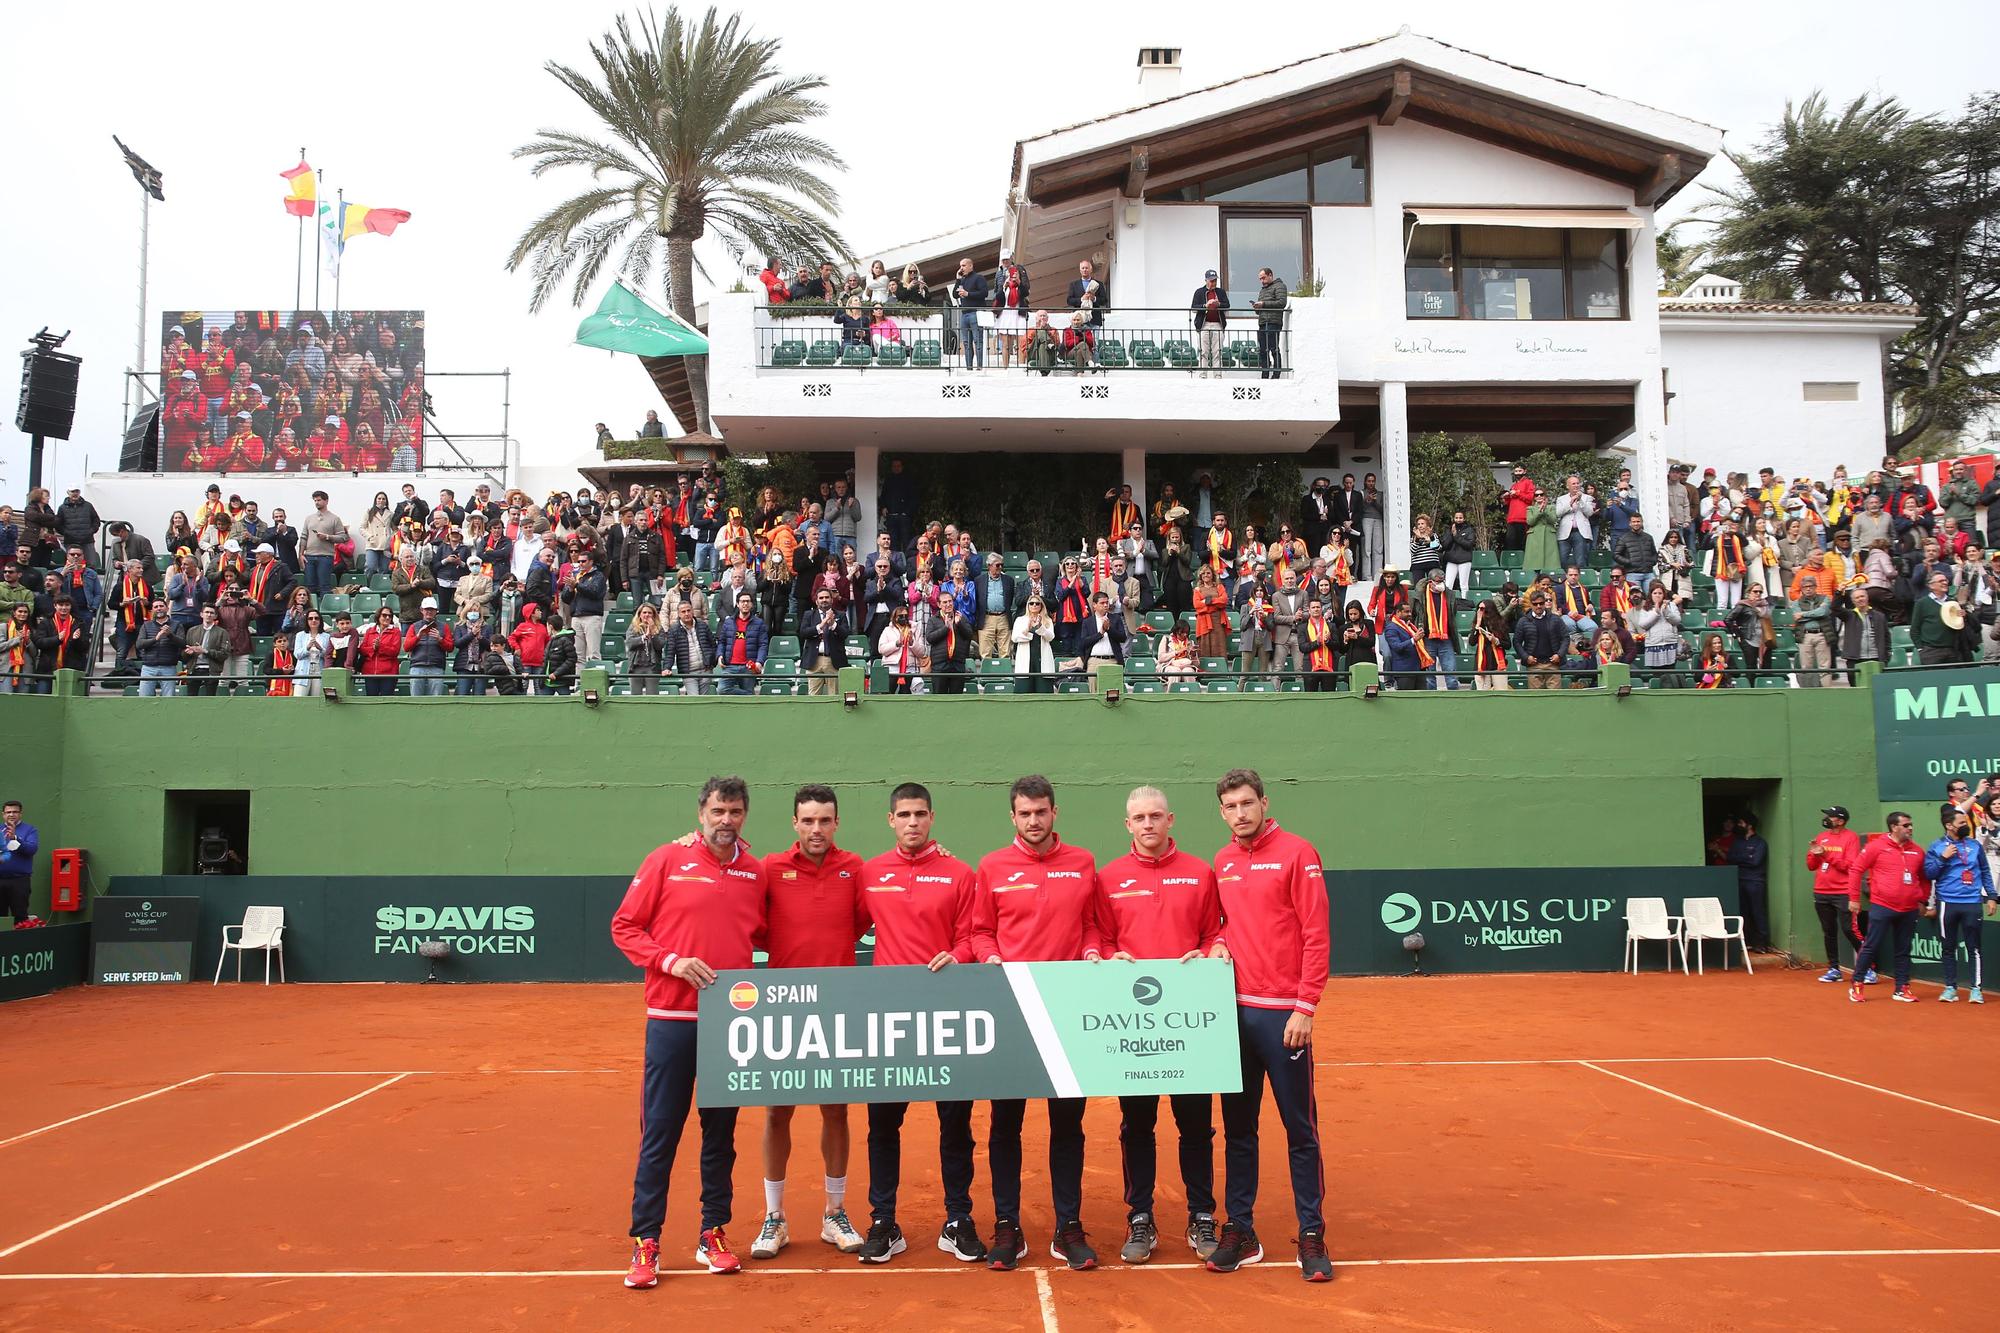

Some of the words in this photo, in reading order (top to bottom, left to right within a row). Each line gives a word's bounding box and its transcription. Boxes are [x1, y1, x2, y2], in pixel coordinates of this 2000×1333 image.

[375, 904, 536, 934] $DAVIS
[1430, 900, 1530, 924] DAVIS
[1540, 898, 1612, 922] CUP
[375, 935, 431, 954] FAN
[439, 935, 535, 954] TOKEN
[1464, 934, 1478, 947] by
[1481, 926, 1562, 950] Rakuten
[103, 972, 130, 982] SERVE
[131, 972, 159, 981] SPEED
[160, 971, 182, 981] km/h
[766, 984, 818, 1004] SPAIN
[1082, 1012, 1156, 1031] DAVIS
[1163, 1011, 1217, 1029] CUP
[728, 1010, 996, 1067] QUALIFIED
[1106, 1044, 1117, 1054] by
[1119, 1037, 1185, 1056] Rakuten
[727, 1071, 762, 1091] SEE
[770, 1069, 806, 1089] YOU
[814, 1069, 833, 1089] IN
[840, 1068, 877, 1088] THE
[884, 1065, 951, 1087] FINALS
[1124, 1070, 1160, 1080] FINALS
[1161, 1069, 1185, 1079] 2022
